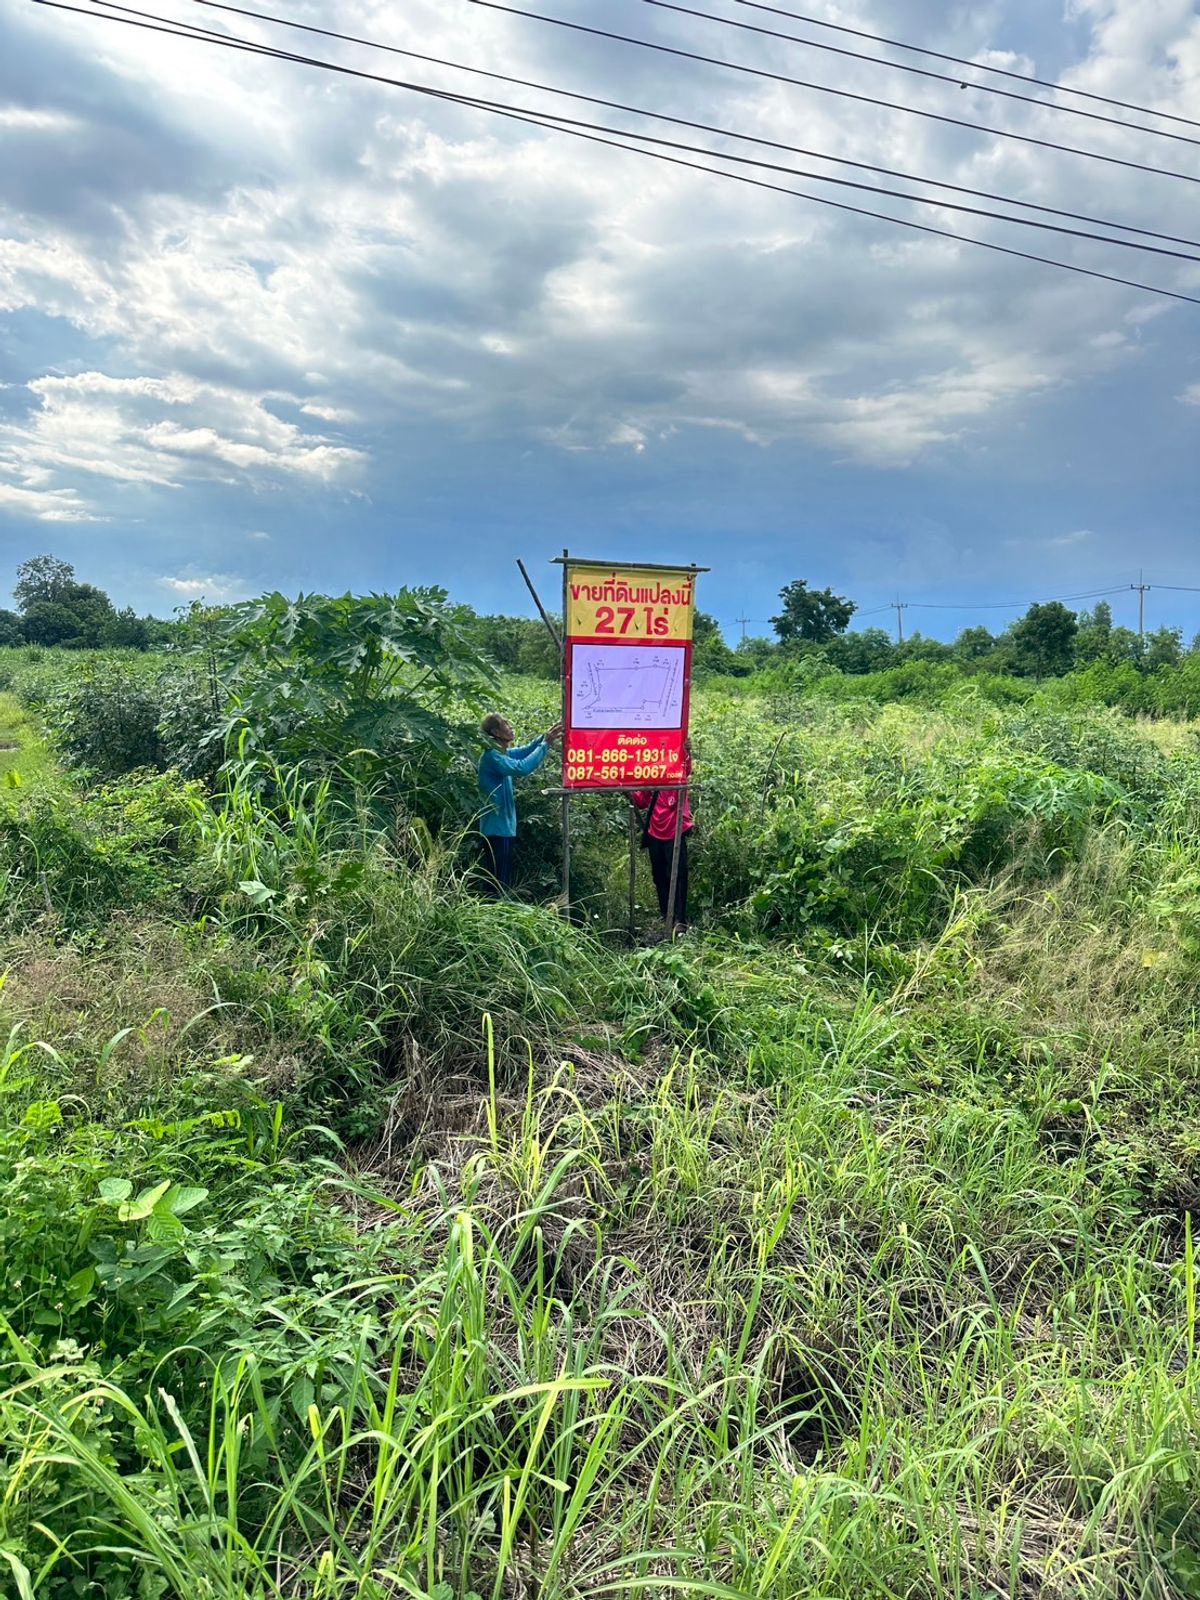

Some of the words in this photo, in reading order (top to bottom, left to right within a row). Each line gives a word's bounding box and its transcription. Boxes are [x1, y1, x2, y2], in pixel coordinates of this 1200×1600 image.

[570, 572, 693, 606] ขายที่ดินแปลงนี้
[594, 606, 636, 634] 27
[643, 607, 669, 635] ไร่
[617, 733, 648, 746] ติดต่อ
[567, 748, 665, 763] 081-866-1931
[567, 765, 667, 780] 087-561-9067
